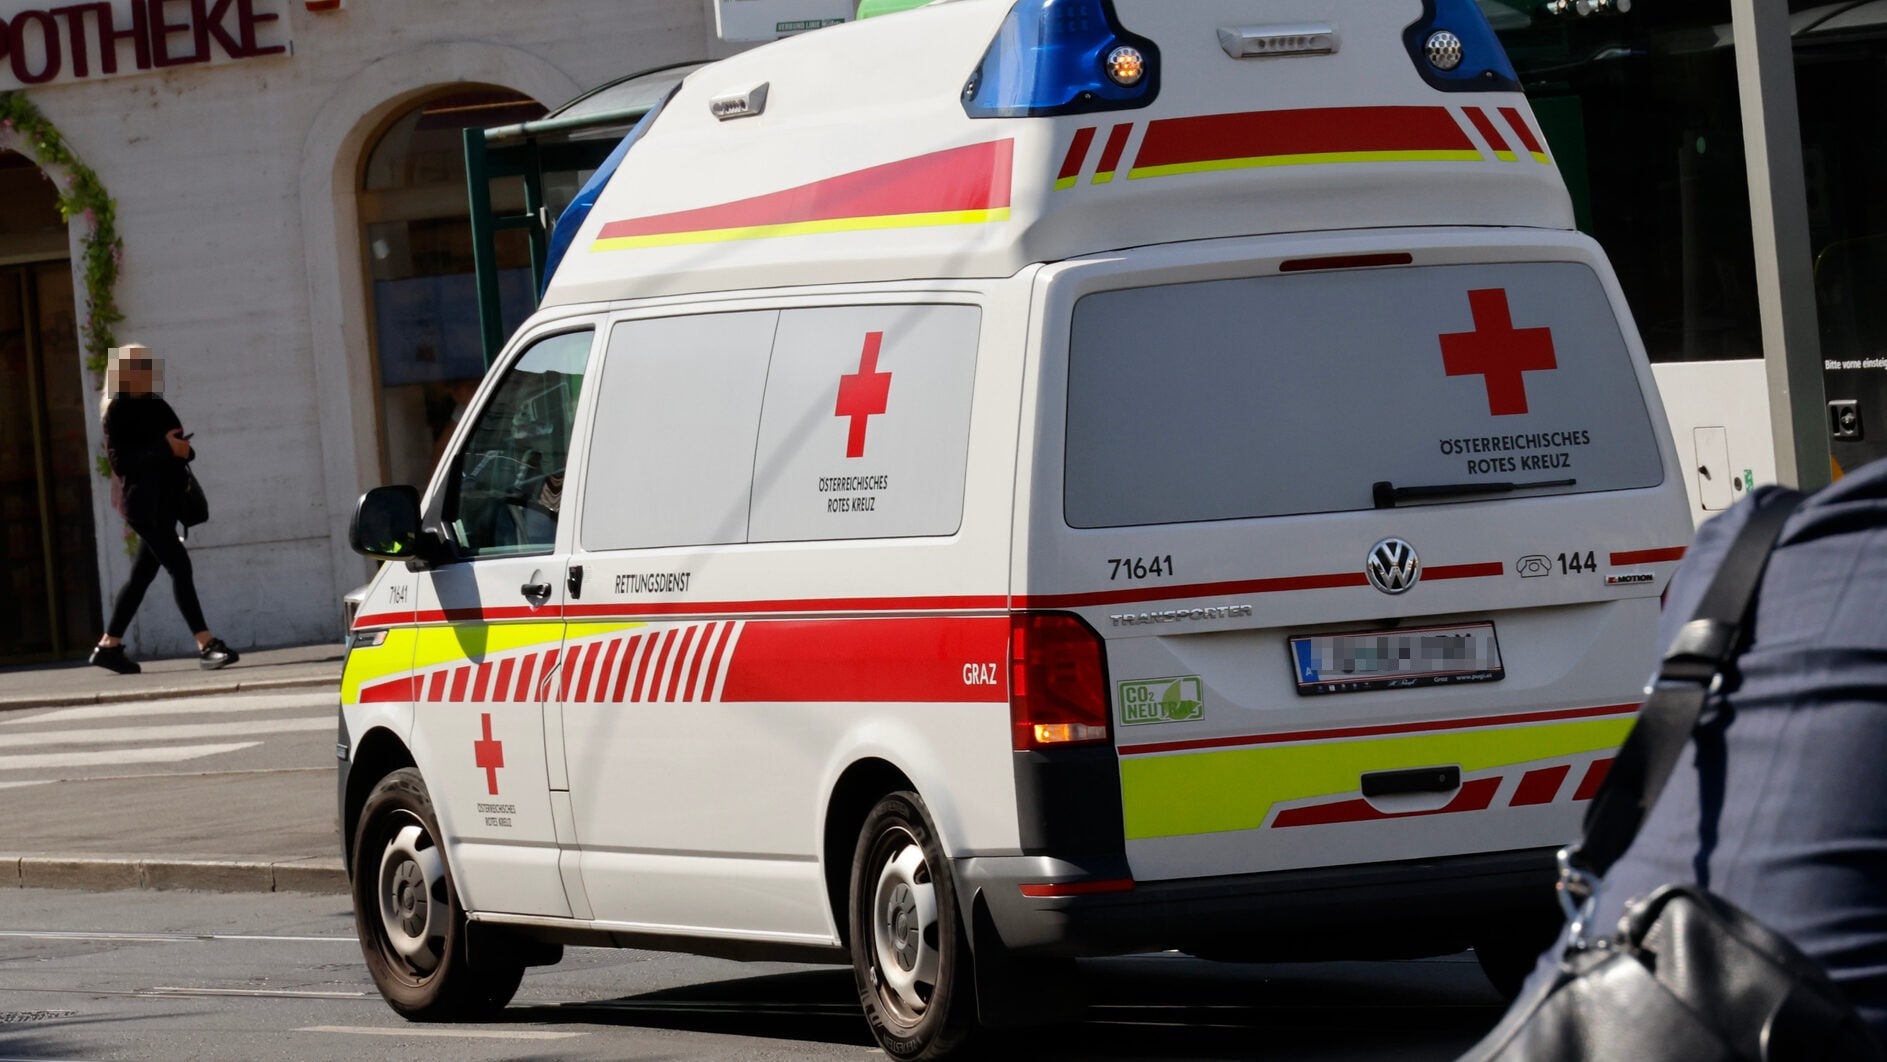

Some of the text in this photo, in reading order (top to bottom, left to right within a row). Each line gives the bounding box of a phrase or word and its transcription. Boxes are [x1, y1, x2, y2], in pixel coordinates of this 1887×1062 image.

[0, 0, 286, 84] OTHEKE
[1825, 360, 1841, 370] Bitte
[1842, 360, 1861, 369] vorne
[1440, 430, 1590, 455] ÖSTERREICHISCHES
[1467, 453, 1571, 474] ROTES KREUZ
[818, 475, 888, 492] ÖSTERREICHISCHES
[827, 497, 875, 512] ROTES KREUZ
[1107, 555, 1174, 580] 71641
[1557, 551, 1597, 575] 144
[614, 572, 691, 594] RETTUNGSDIENST
[389, 585, 408, 604] 71641
[1109, 604, 1253, 627] TRANSPORTER
[963, 663, 998, 685] GRAZ
